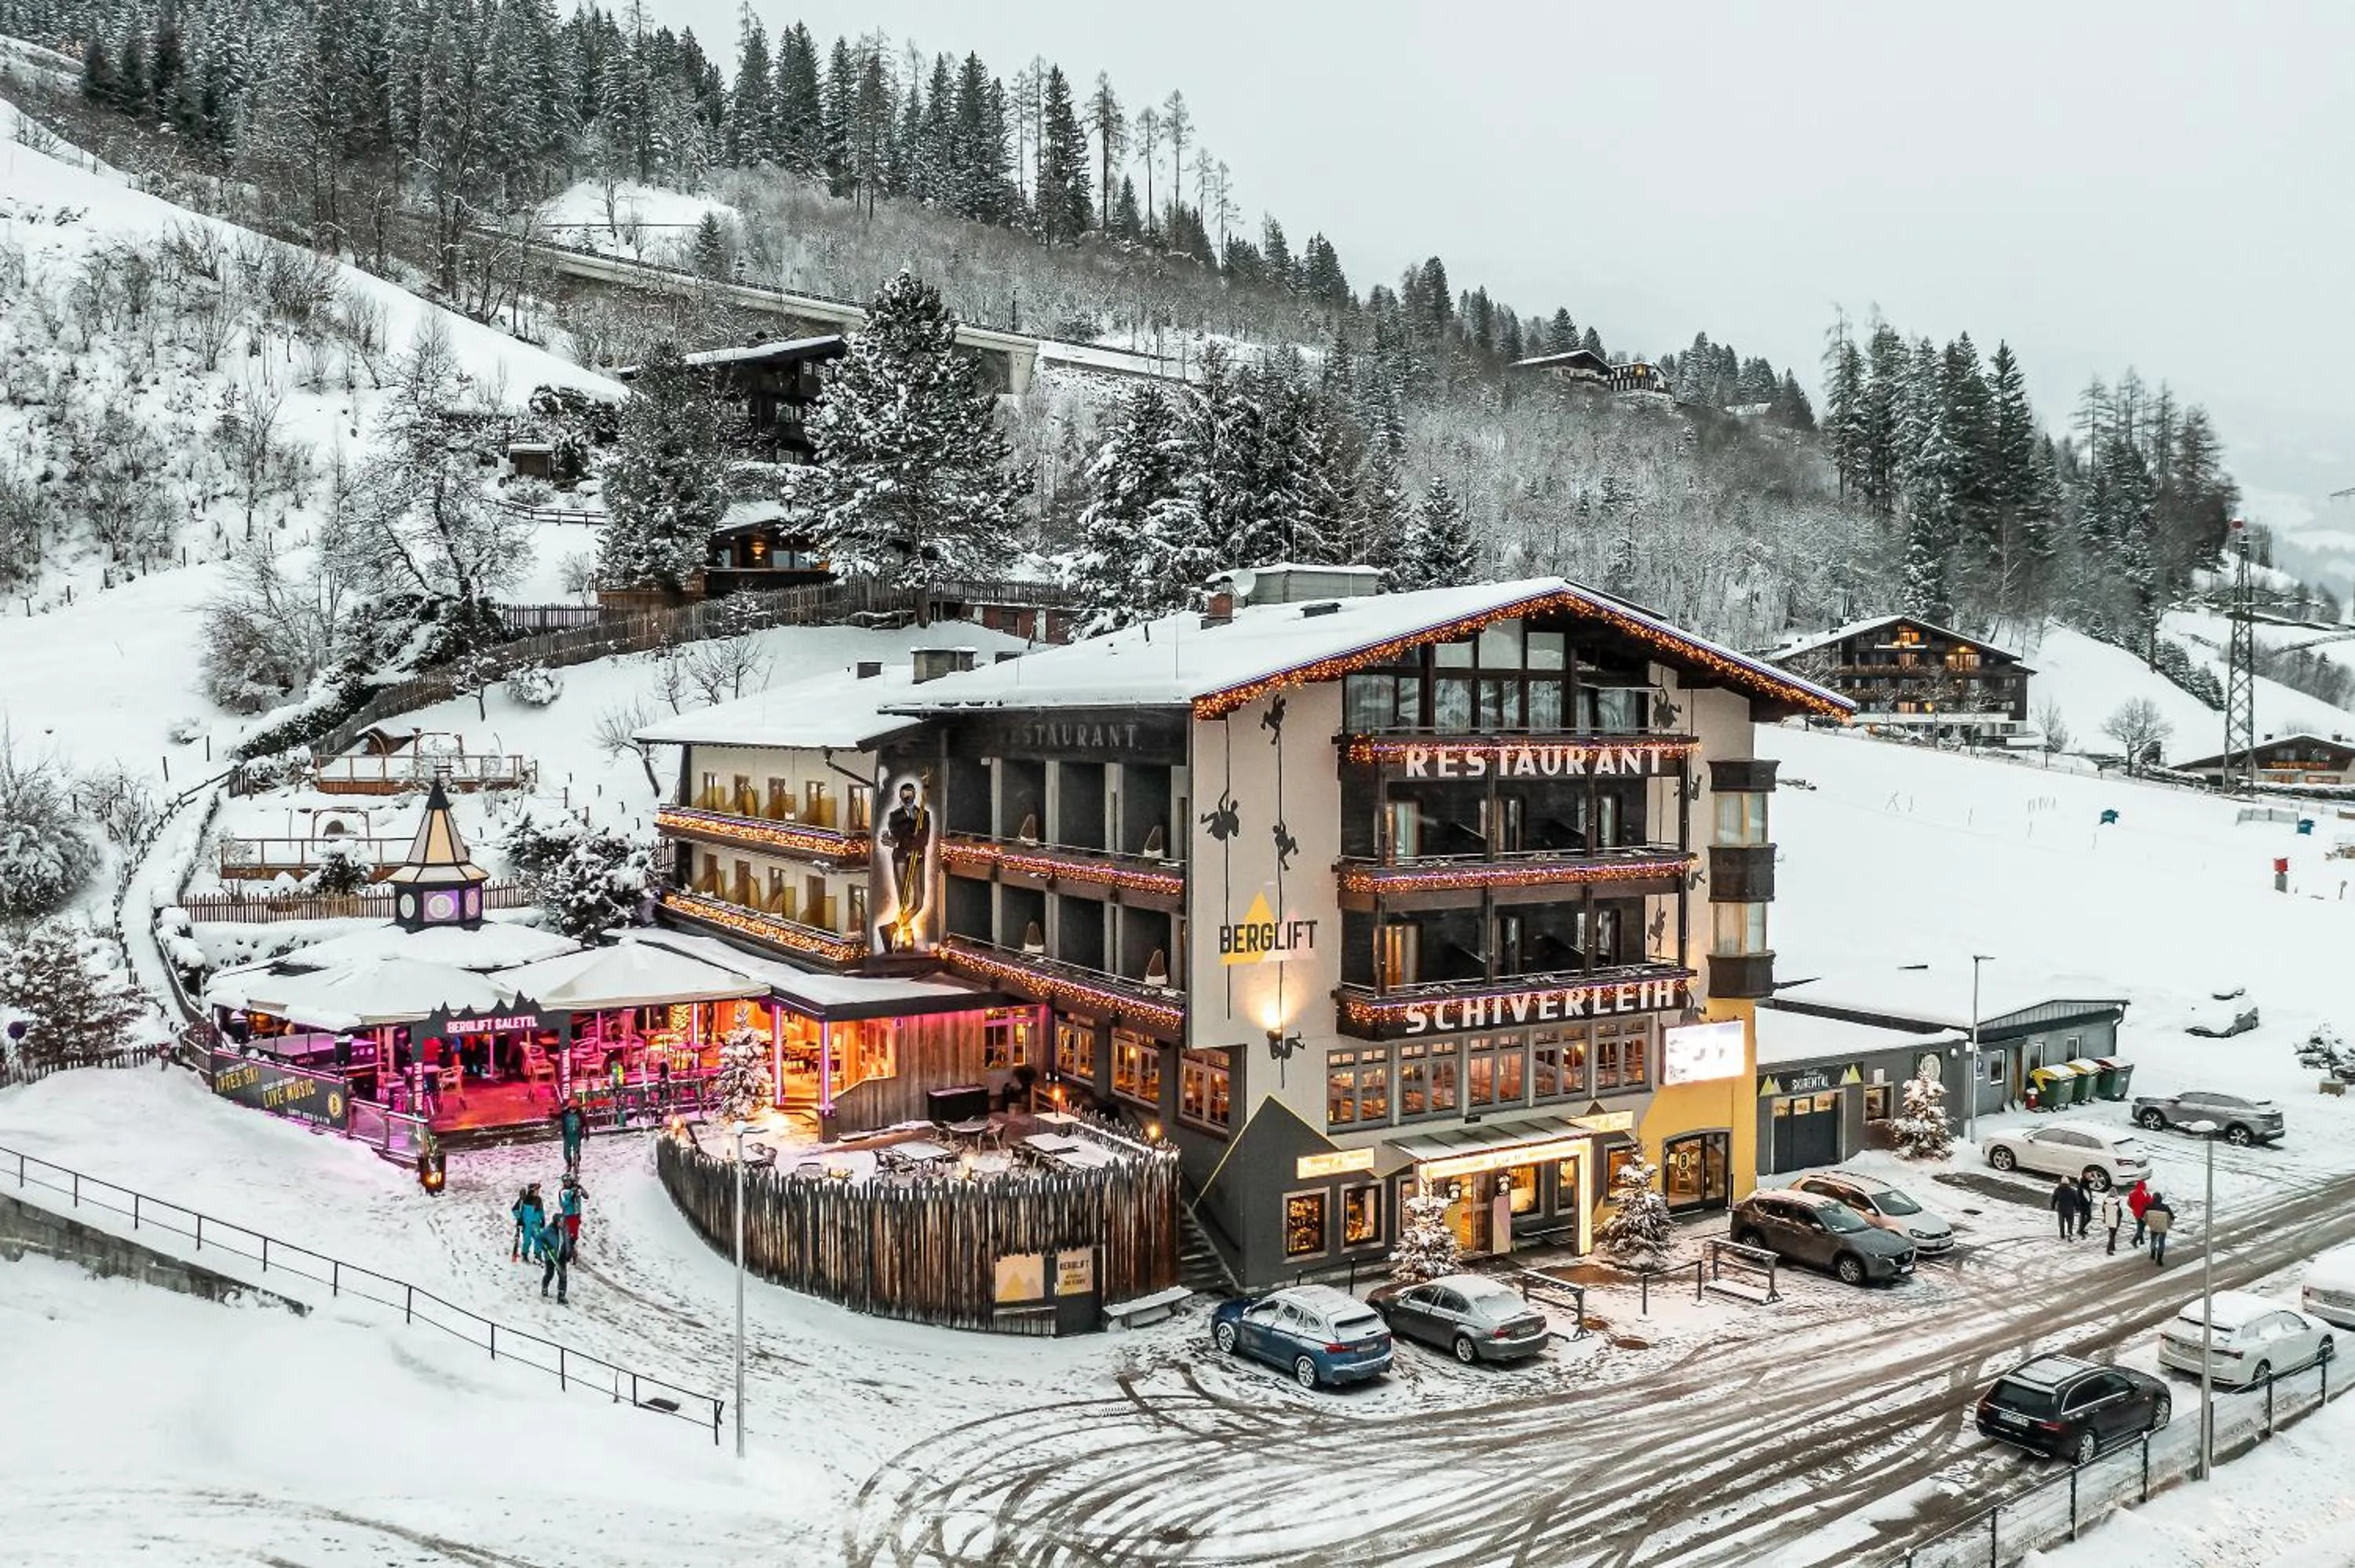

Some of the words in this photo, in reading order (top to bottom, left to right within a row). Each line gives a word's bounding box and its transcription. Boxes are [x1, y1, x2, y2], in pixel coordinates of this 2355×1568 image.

[999, 724, 1137, 748] STAURANT
[1406, 746, 1660, 778] RESTAURANT
[1219, 920, 1317, 954] BERGLIFT
[1406, 978, 1675, 1034] SCHIVERLEIH
[287, 1078, 316, 1101] MUSIC
